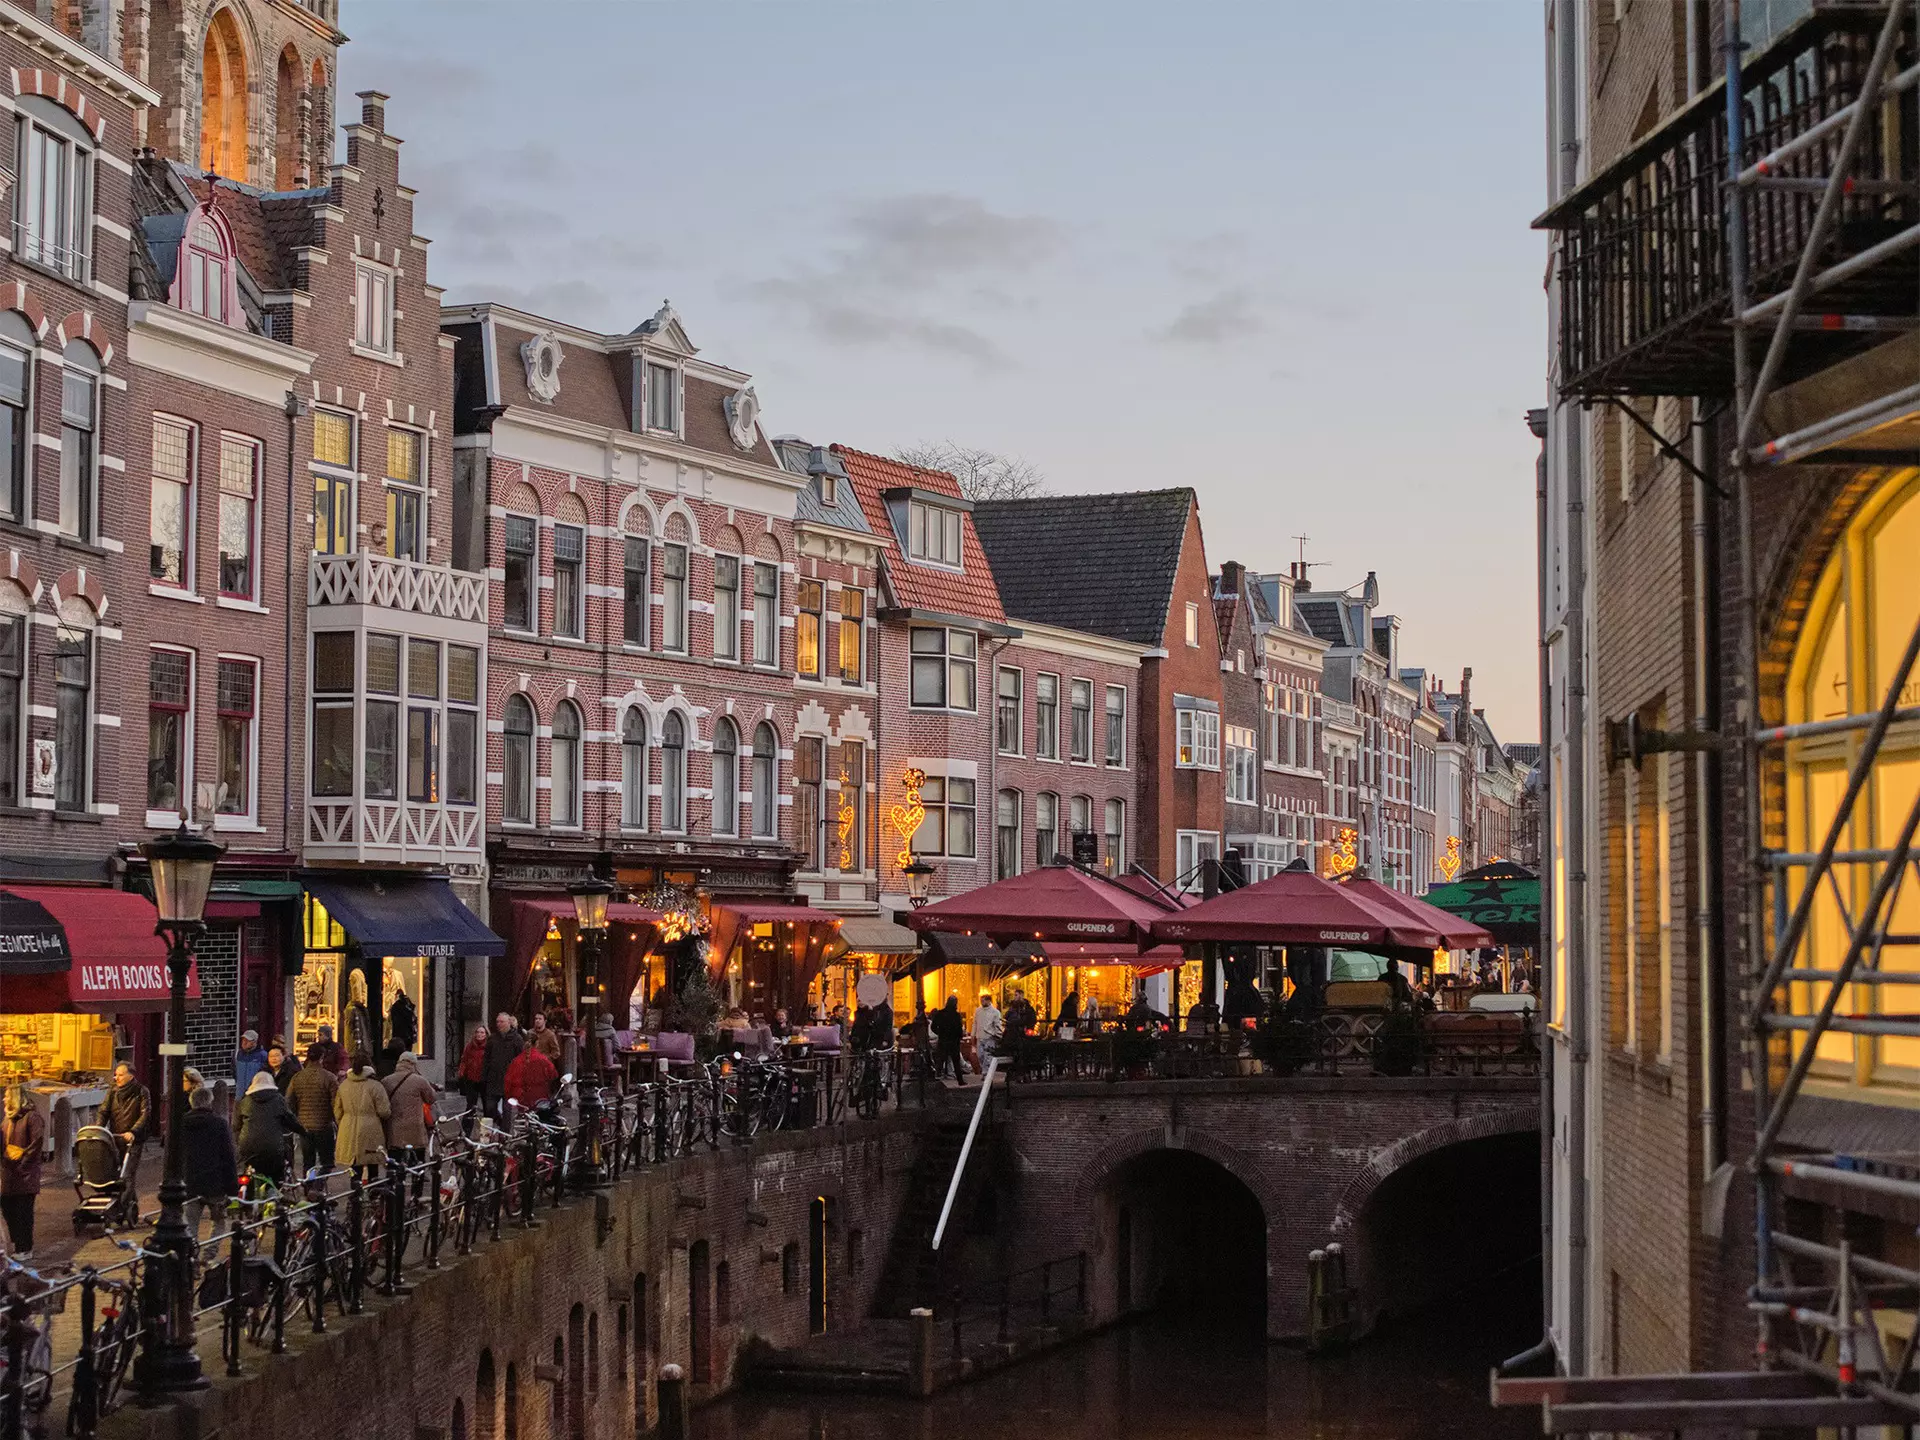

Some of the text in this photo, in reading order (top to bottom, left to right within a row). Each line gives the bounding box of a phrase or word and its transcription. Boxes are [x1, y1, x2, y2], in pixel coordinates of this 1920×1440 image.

[1067, 922, 1106, 933] GULPENER
[1320, 930, 1361, 941] GULPENER
[417, 944, 455, 956] SUITABLE
[82, 965, 121, 990] ALEPH
[122, 965, 162, 990] BOOKS
